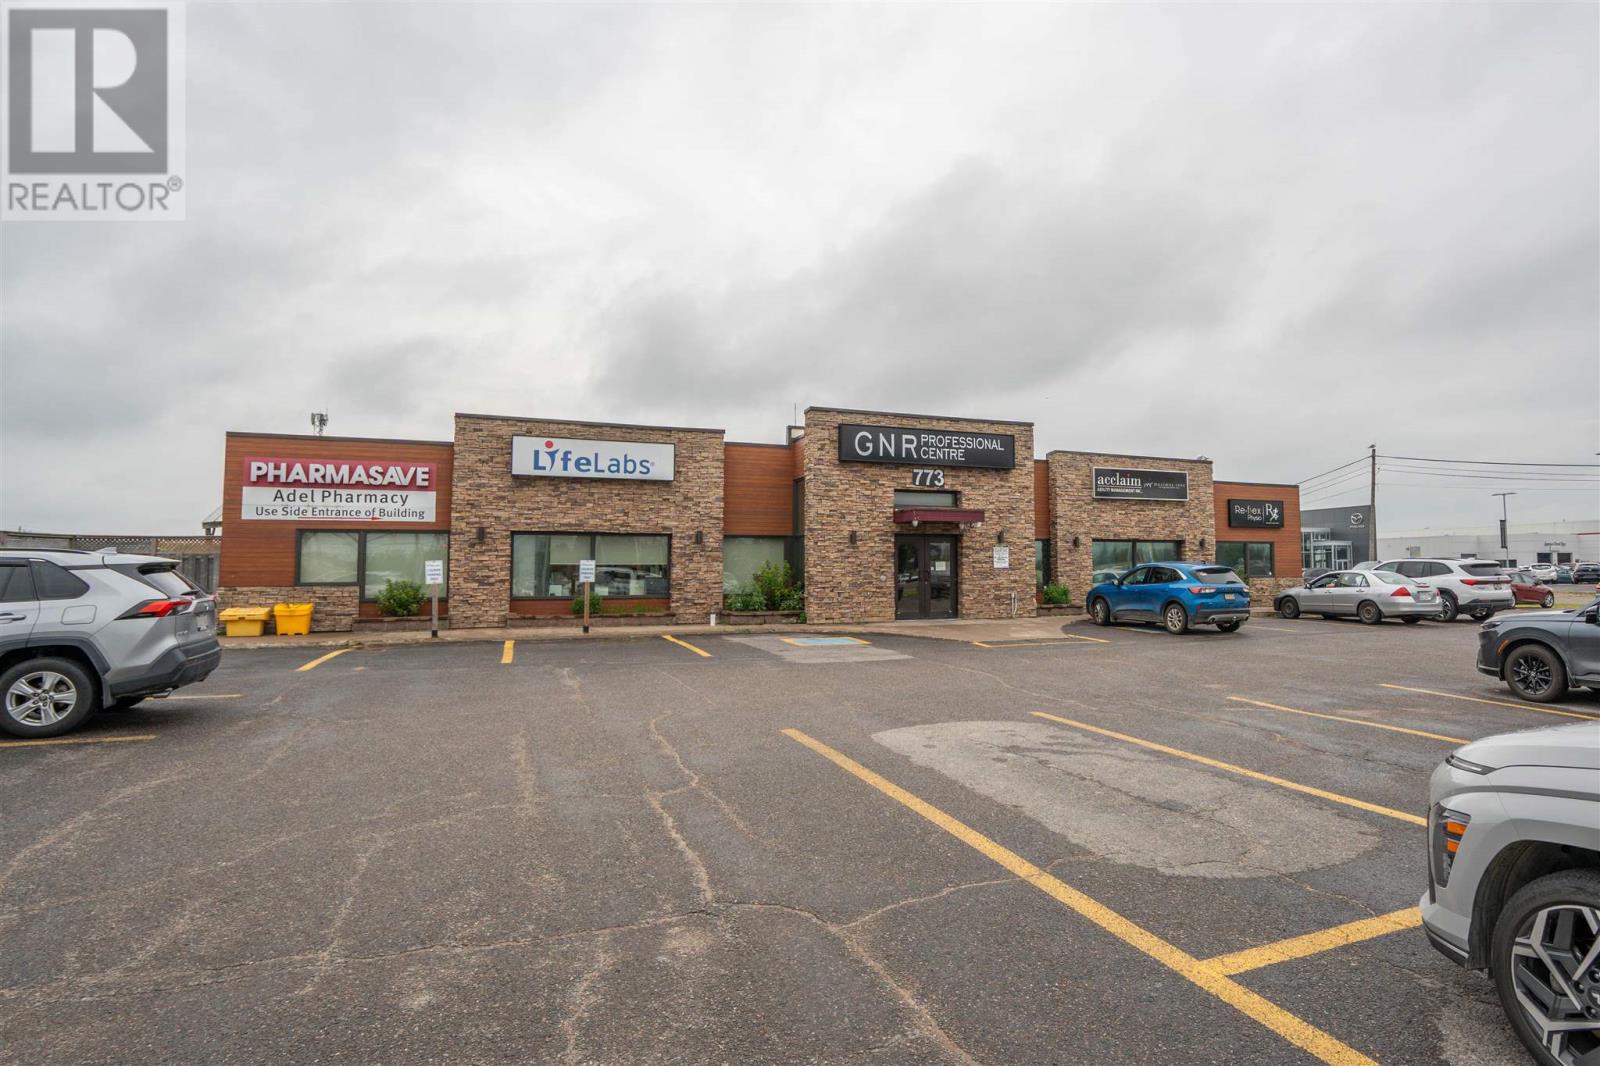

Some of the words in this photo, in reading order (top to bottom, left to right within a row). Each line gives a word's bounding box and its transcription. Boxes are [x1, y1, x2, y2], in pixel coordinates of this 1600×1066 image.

[920, 434, 1005, 451] PROFESSIONAL
[920, 447, 965, 461] CENTRE
[250, 461, 430, 486] PHARMASAVE
[912, 469, 945, 486] 773
[1097, 473, 1142, 487] acclaim
[273, 489, 315, 503] Adel
[321, 490, 409, 507] Pharmacy
[255, 506, 278, 516] Use
[281, 507, 308, 517] Side
[311, 507, 362, 518] Entrance
[364, 507, 377, 518] of
[378, 508, 425, 520] Building
